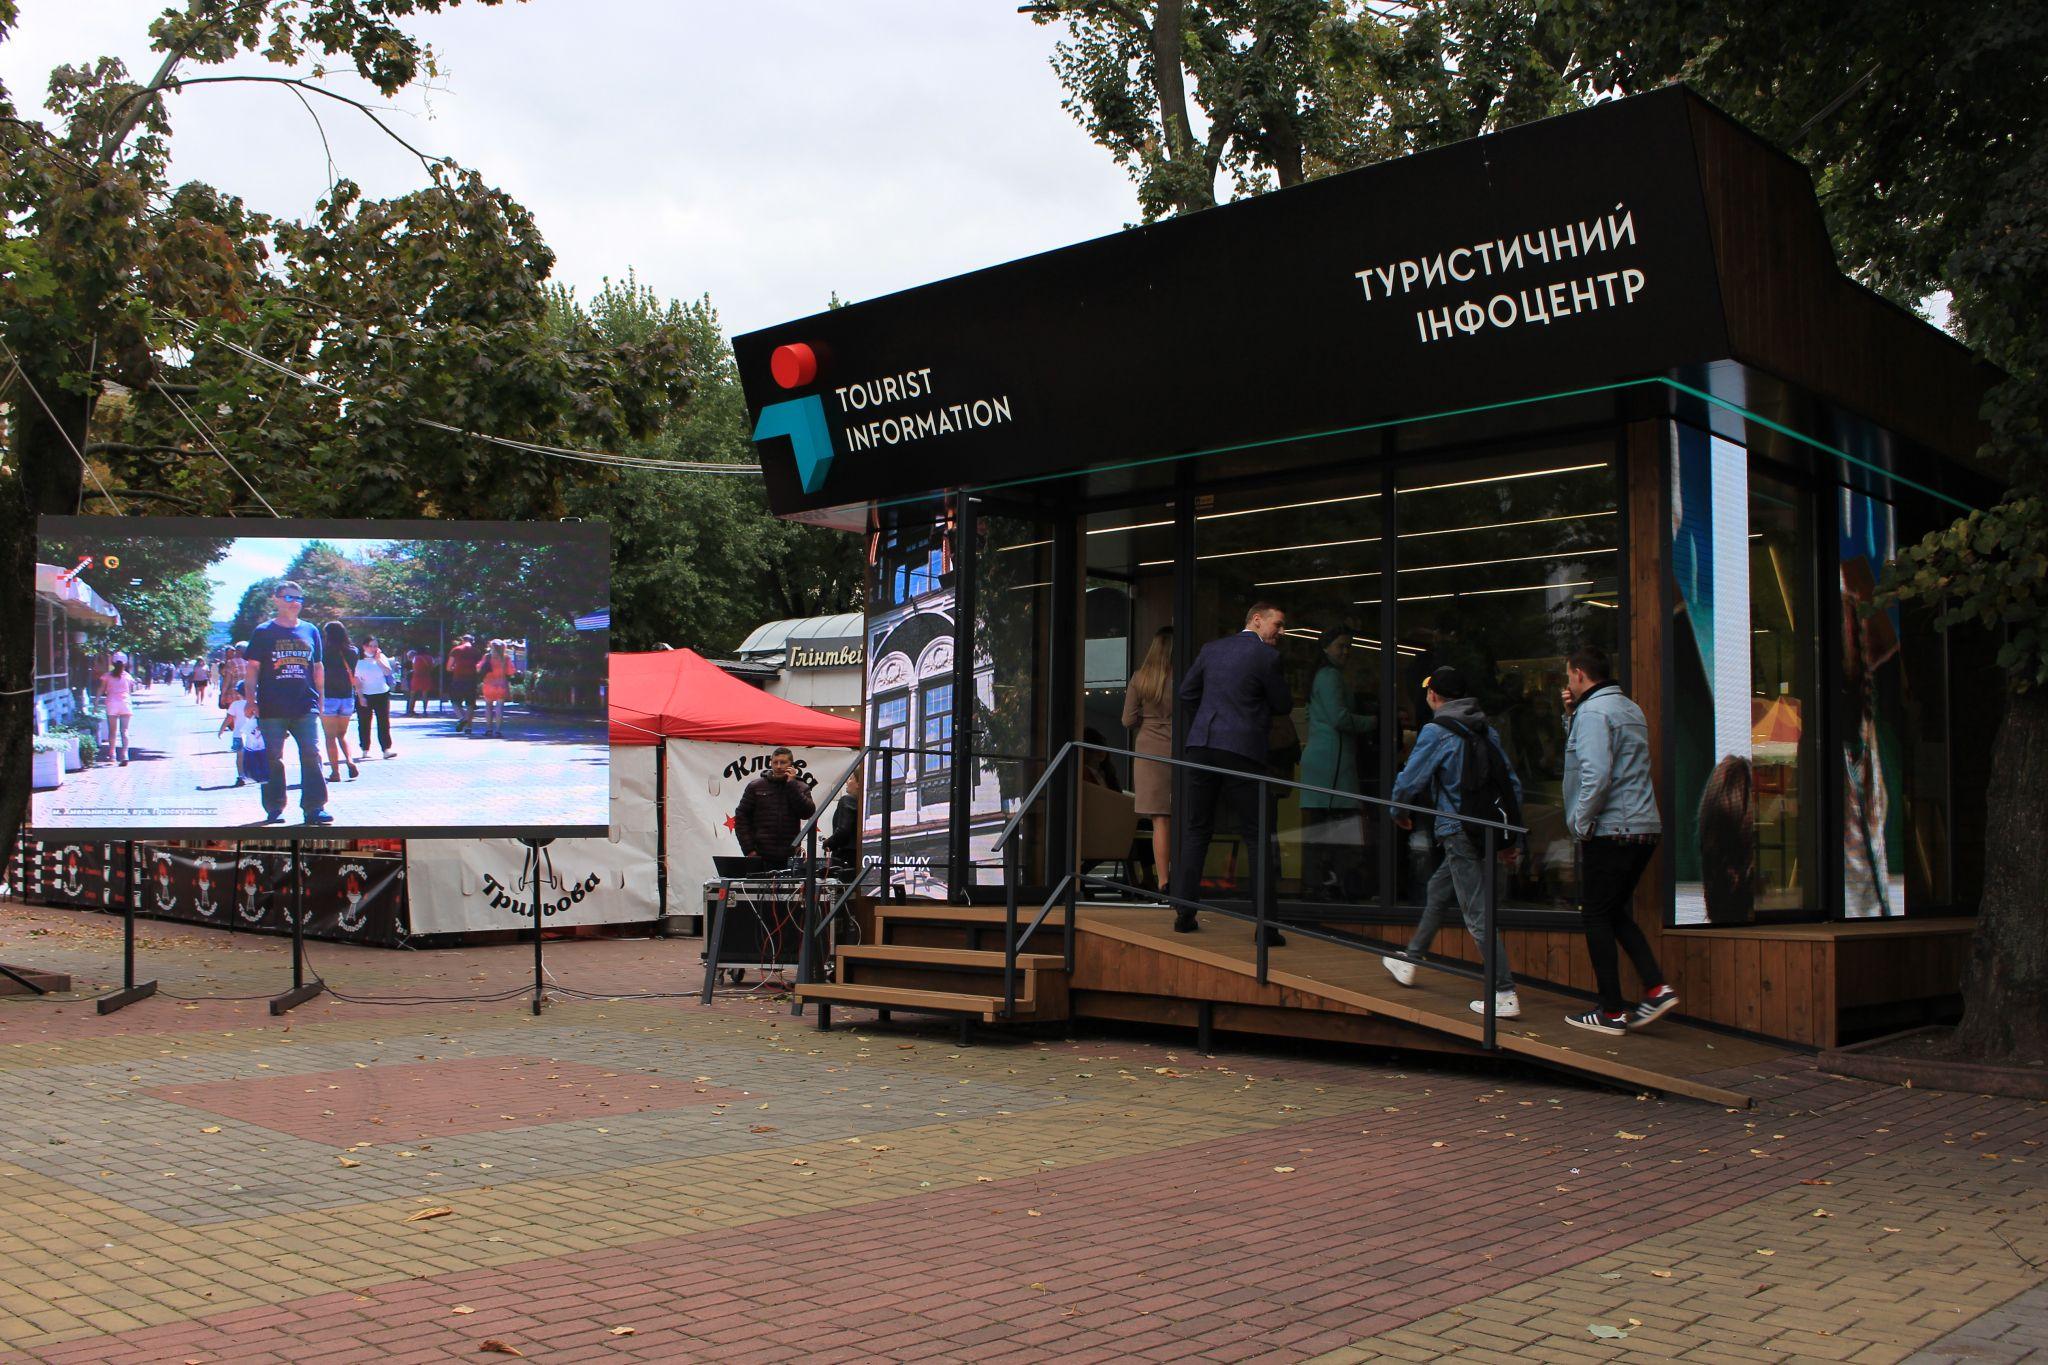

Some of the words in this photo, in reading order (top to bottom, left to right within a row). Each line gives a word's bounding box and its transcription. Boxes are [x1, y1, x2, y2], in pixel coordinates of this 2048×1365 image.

[1354, 202, 1637, 301] ТУРИСТИЧНИЙ
[1416, 268, 1646, 343] ІНФОЦЕНТР
[836, 367, 933, 412] TOURIST
[846, 395, 1013, 452] INFORMATION
